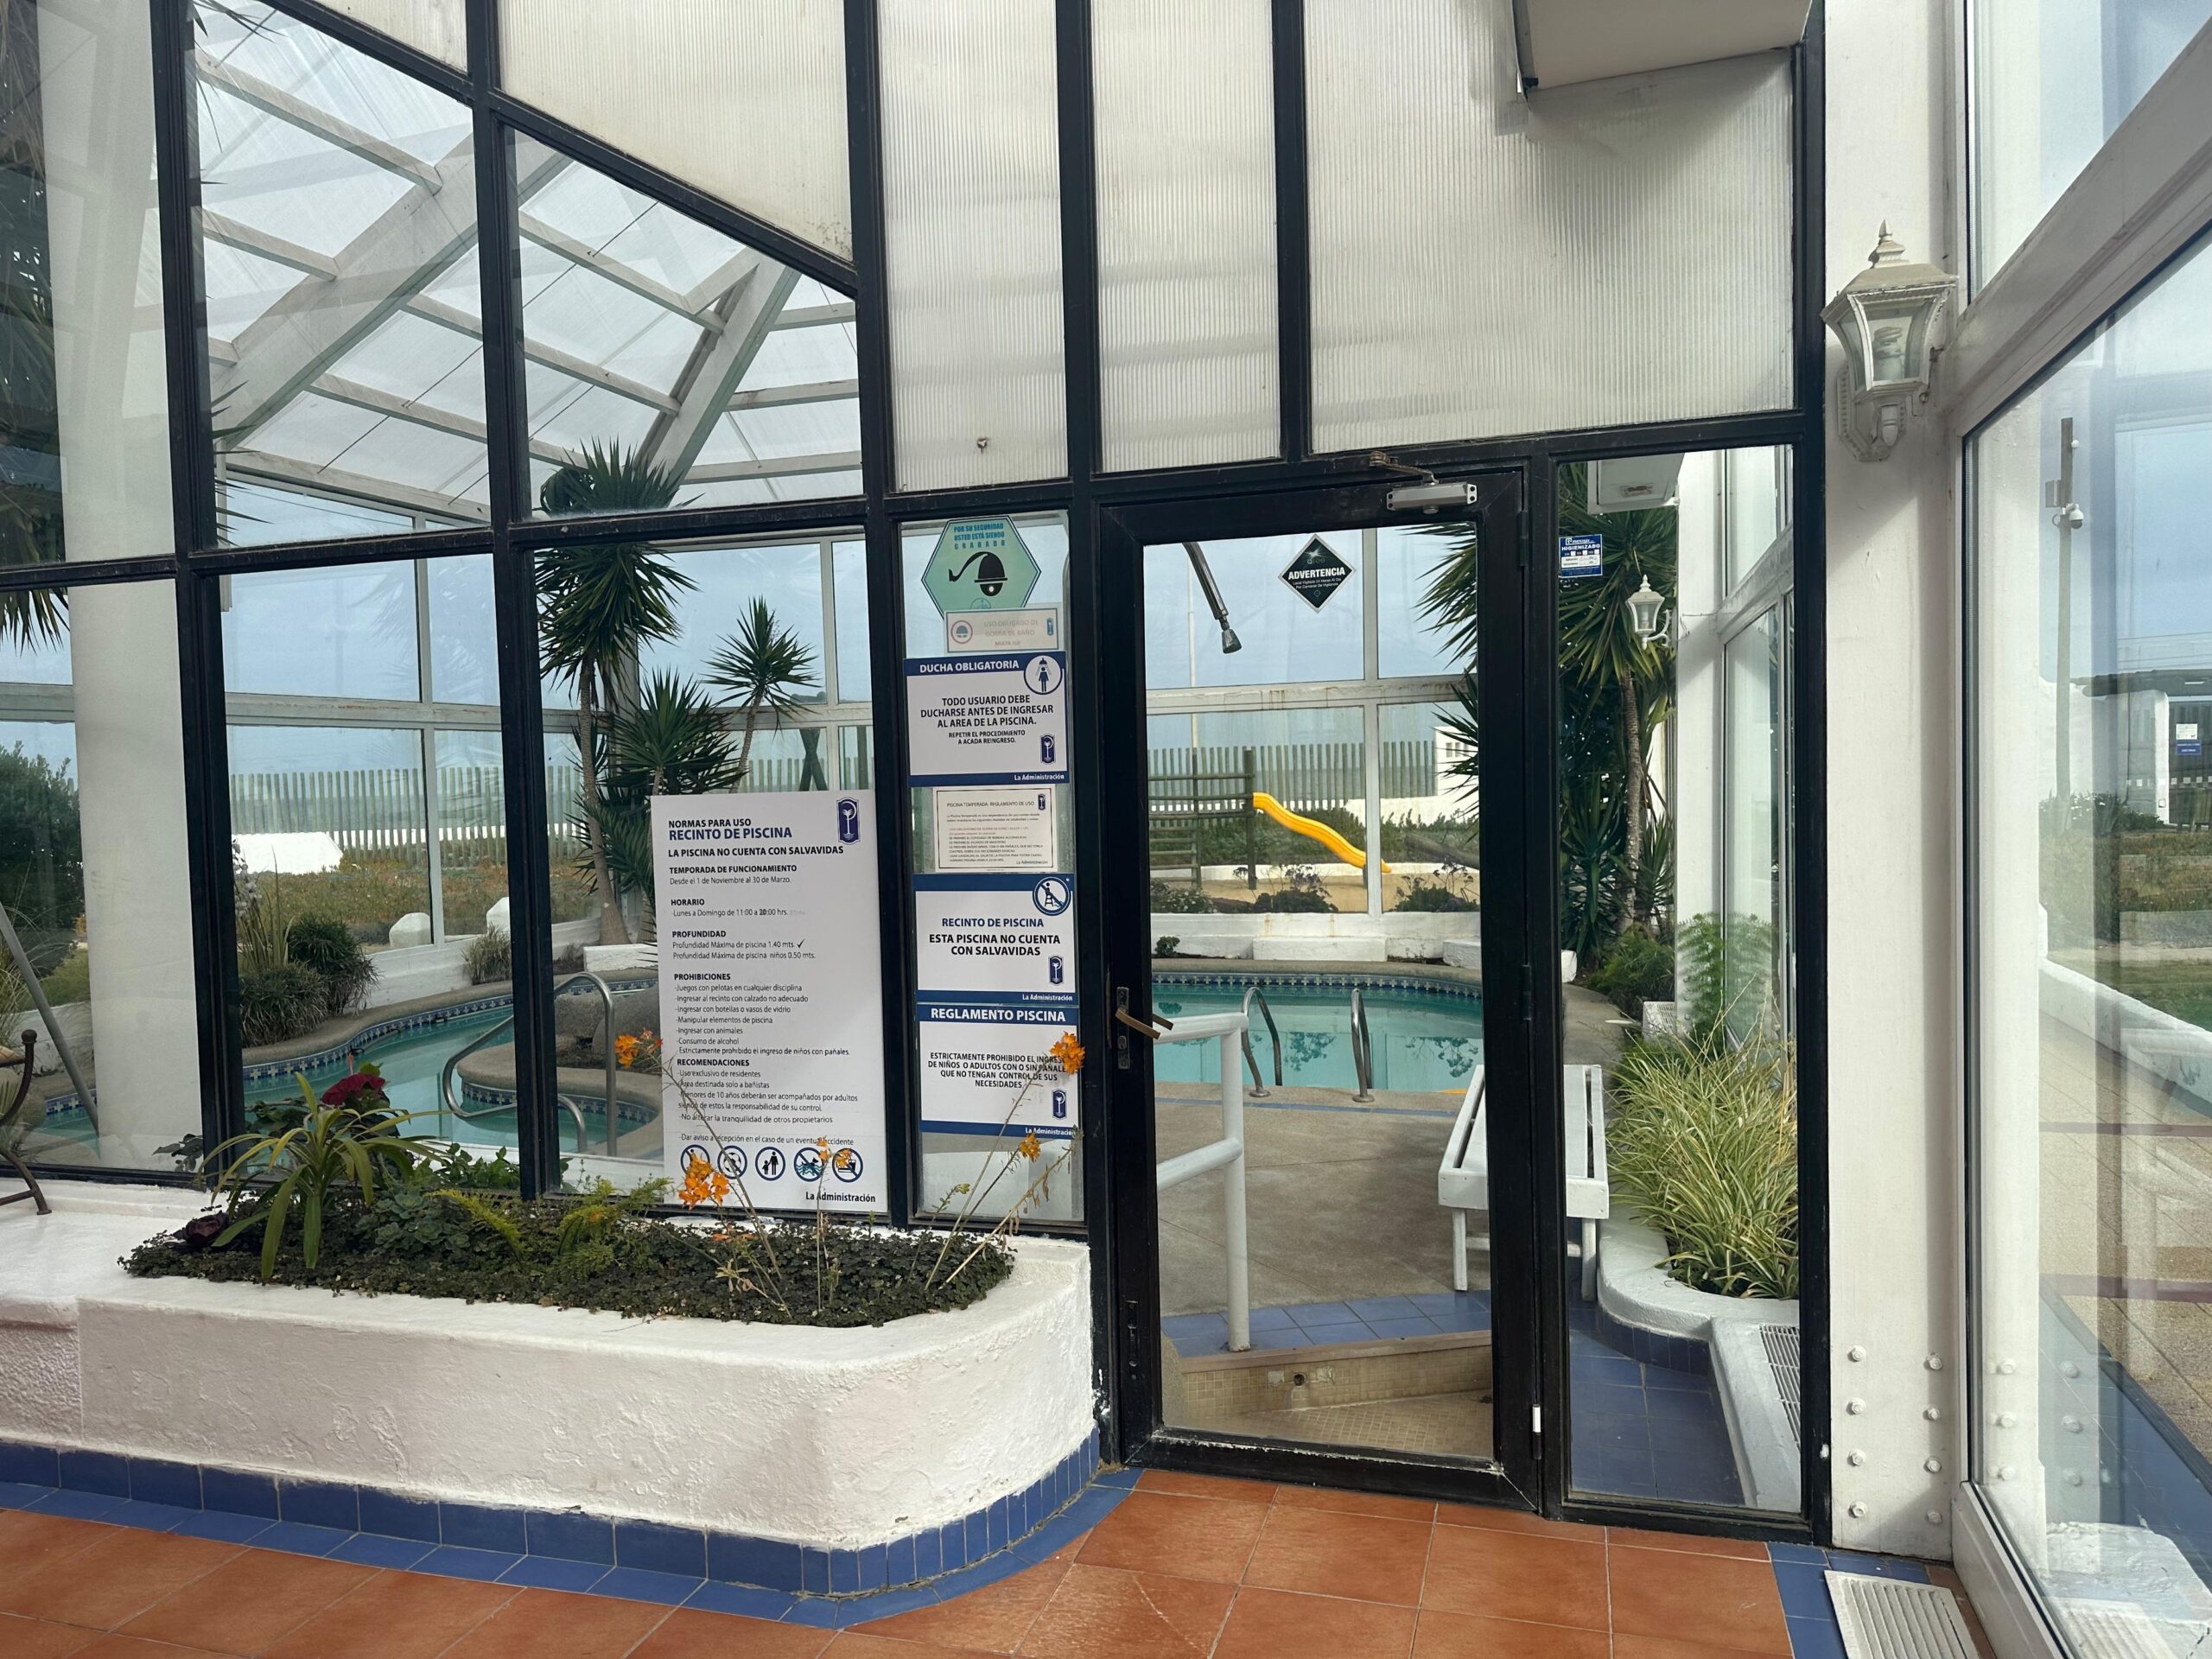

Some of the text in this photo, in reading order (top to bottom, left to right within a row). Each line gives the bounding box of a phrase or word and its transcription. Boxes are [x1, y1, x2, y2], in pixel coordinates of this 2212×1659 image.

[974, 523, 1004, 531] SEGURIDAD
[972, 531, 985, 540] ESTÁ
[1288, 568, 1345, 579] ADVERTENCIA
[920, 660, 1020, 672] DUCHA OBLIGATORIA
[942, 695, 1030, 706] TODO USUARIO DEBE
[921, 709, 966, 717] DUCHARSE
[968, 707, 995, 715] ANTES
[1010, 705, 1053, 714] INGRESAR
[950, 719, 972, 728] AREA
[974, 718, 985, 727] DE
[1000, 716, 1037, 725] PISCINA.
[733, 818, 752, 827] USO
[669, 827, 792, 841] RECINTO DE PISCINA
[681, 849, 715, 857] PISCINA
[768, 847, 786, 855] CON
[789, 846, 843, 855] SALVAVIDAS
[697, 909, 726, 918] Domingo
[942, 918, 1044, 927] RECINTO DE PISCINA
[930, 934, 1060, 944] ESTA PISCINA NO CUENTA
[951, 946, 1040, 956] CON SALVAVIDAS
[931, 1008, 1066, 1021] REGLAMENTO PISCINA
[1037, 1055, 1065, 1064] INGRES
[1019, 1062, 1024, 1071] O
[1026, 1062, 1038, 1071] SIN
[1043, 1072, 1058, 1081] SUS
[976, 1080, 1023, 1089] NECESIDADES
[805, 1191, 875, 1202] La Administración
